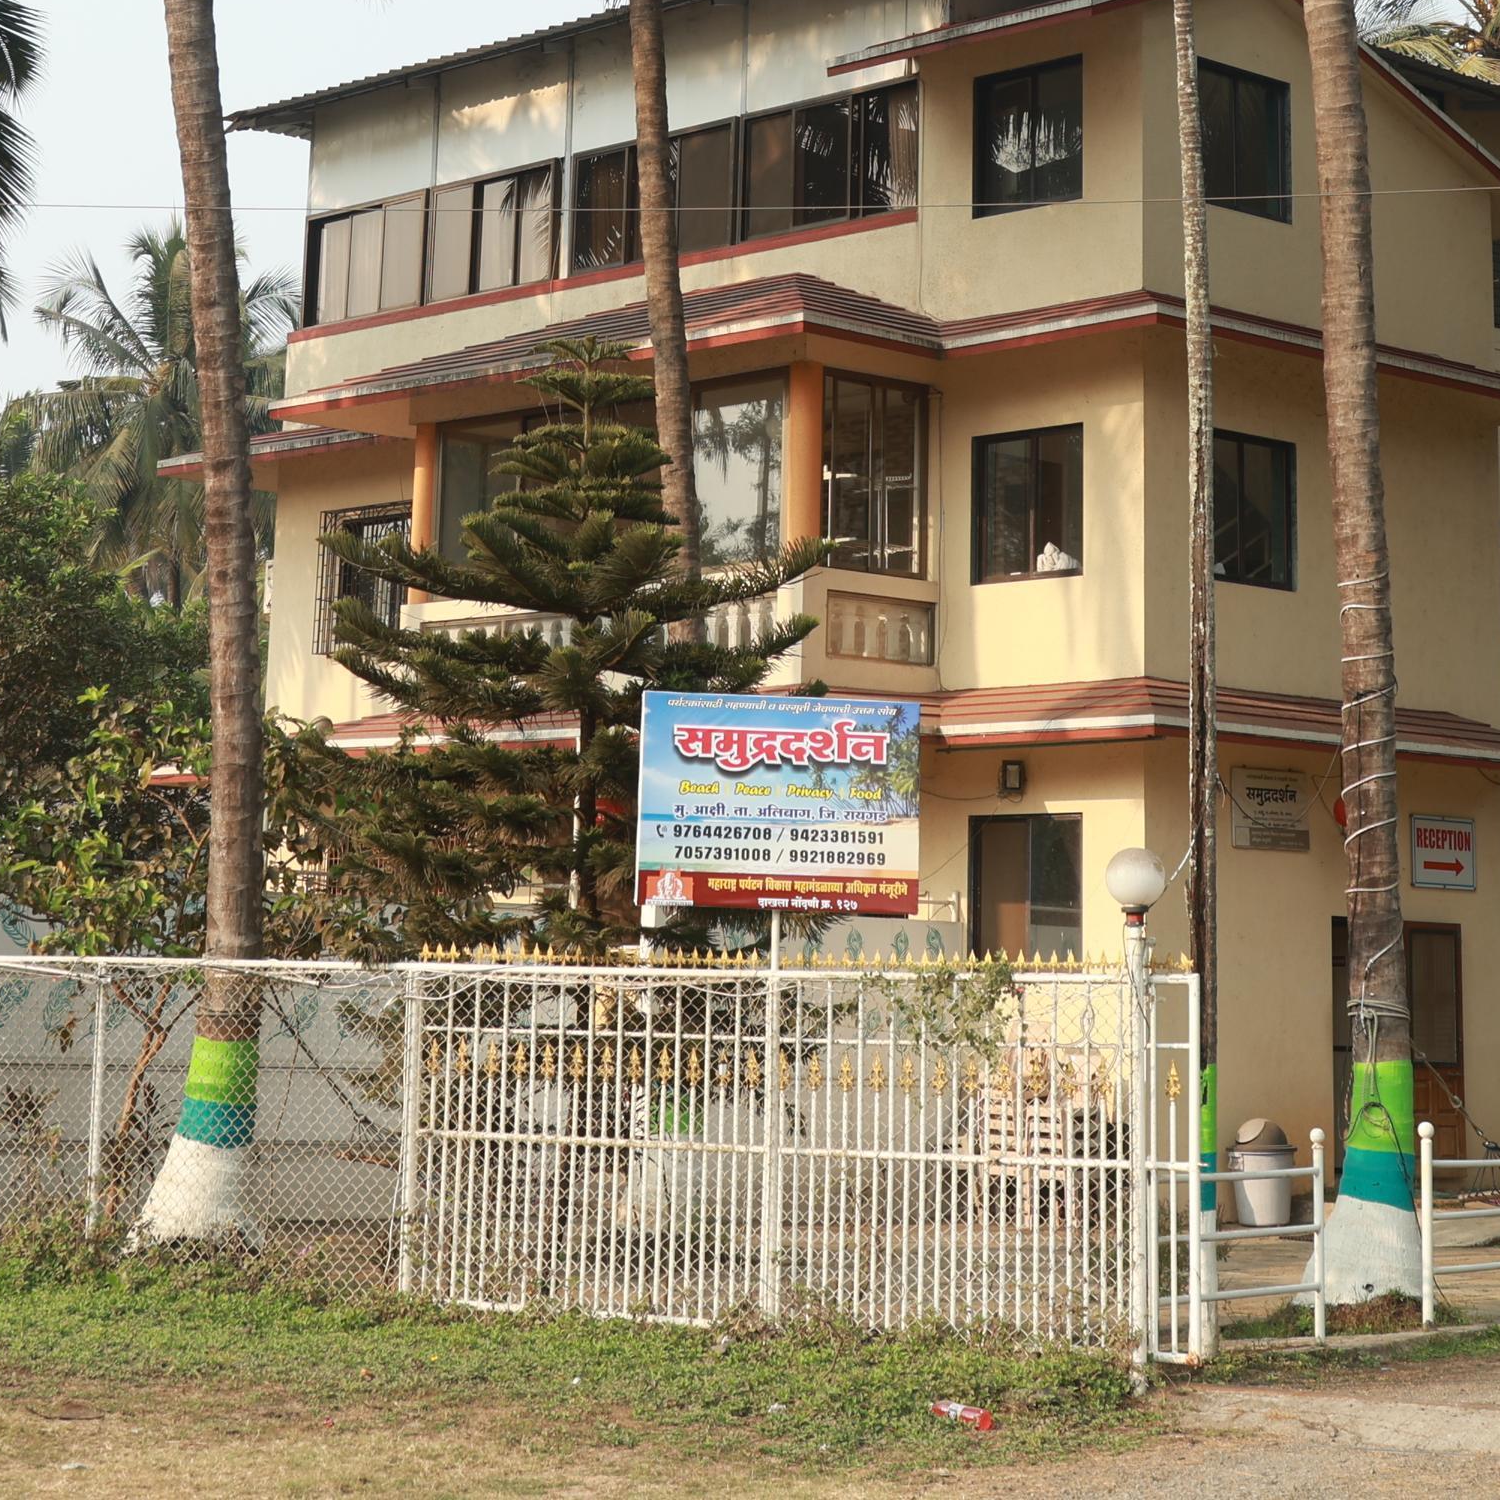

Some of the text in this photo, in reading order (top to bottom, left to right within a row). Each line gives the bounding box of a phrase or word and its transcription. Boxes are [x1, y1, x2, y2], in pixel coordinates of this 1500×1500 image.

[673, 719, 890, 771] समुद्रदर्शन
[679, 780, 883, 800] Beach Peace Privacy Food
[1246, 784, 1298, 806] समुद्रदर्शन
[843, 809, 887, 821] रायगड
[673, 824, 772, 841] 9764426708
[789, 828, 884, 845] 9423381591
[1416, 827, 1471, 852] RECEPTION
[674, 845, 771, 861] 7057391008
[789, 849, 886, 866] 9921882969
[765, 877, 792, 891] विकास
